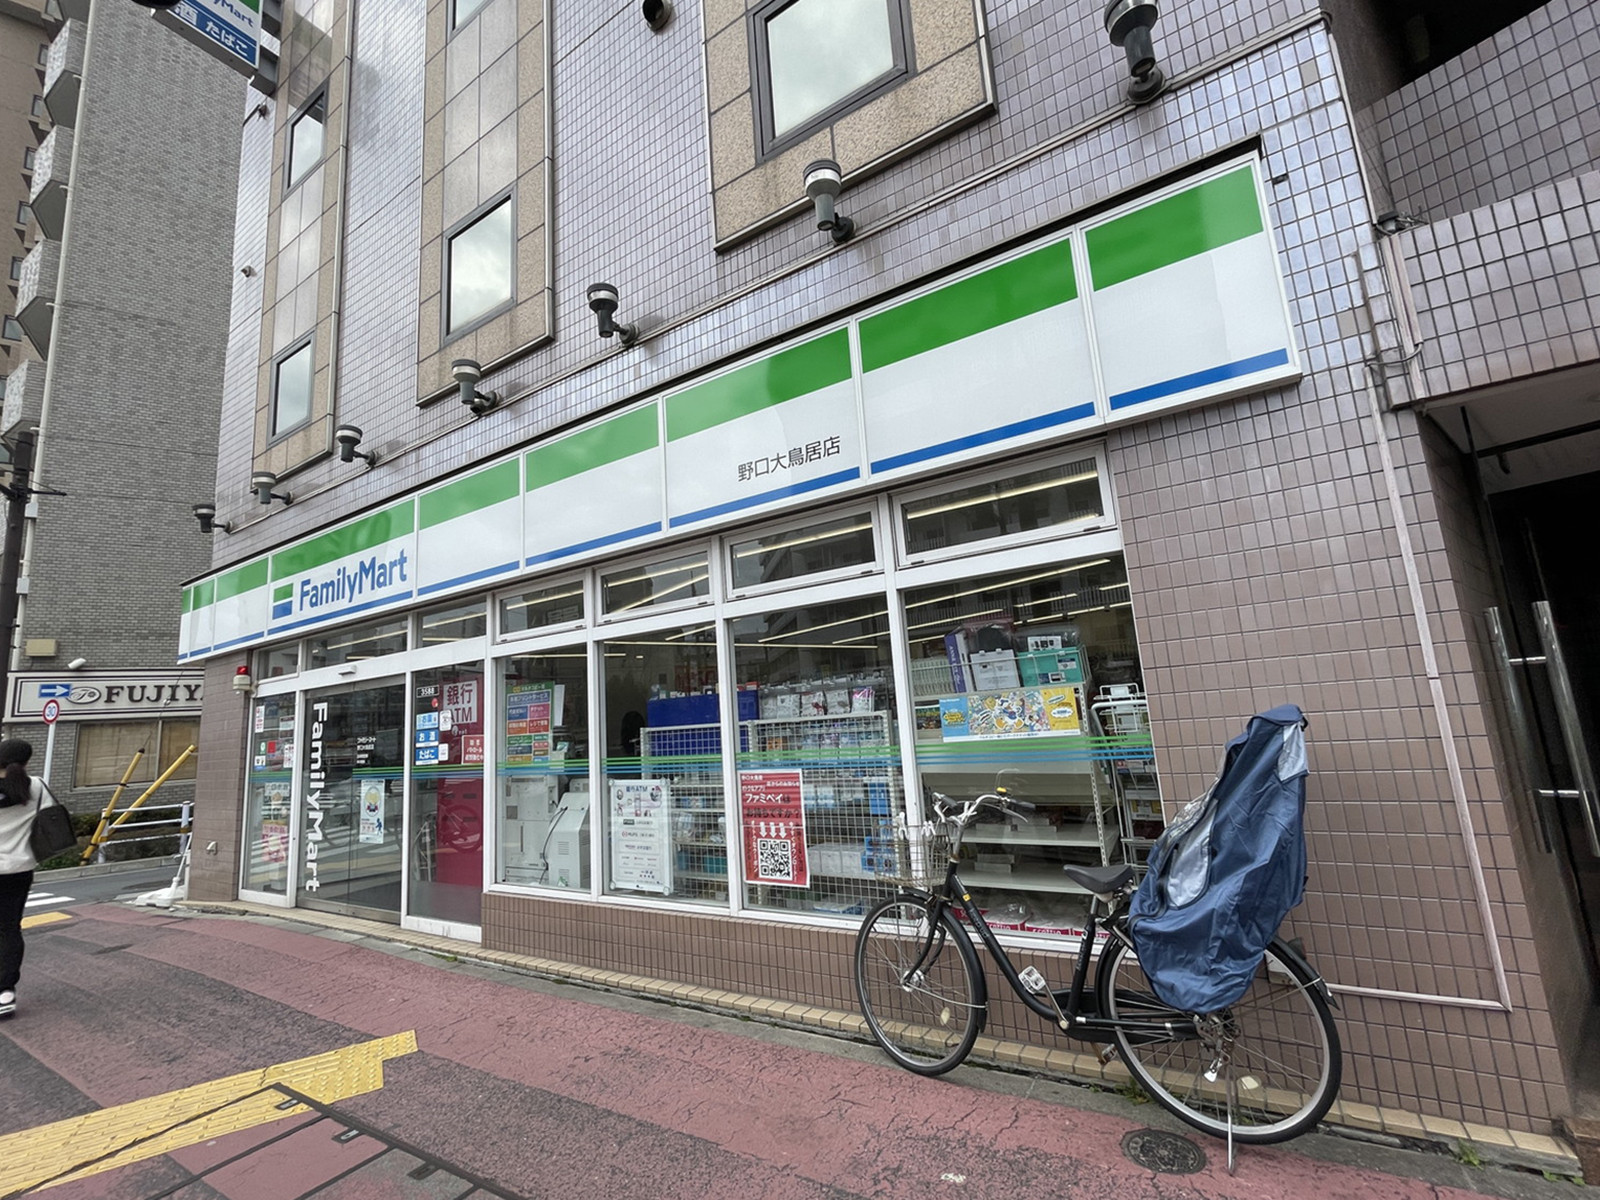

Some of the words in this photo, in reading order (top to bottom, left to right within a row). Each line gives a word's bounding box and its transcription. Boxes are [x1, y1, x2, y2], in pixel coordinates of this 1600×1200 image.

[205, 21, 248, 57] たばこ
[738, 436, 840, 481] 野口大鳥居店
[299, 549, 407, 611] FamilyMart
[104, 685, 202, 704] FUJIY
[447, 684, 473, 705] 銀行
[306, 702, 328, 893] FamilyMart
